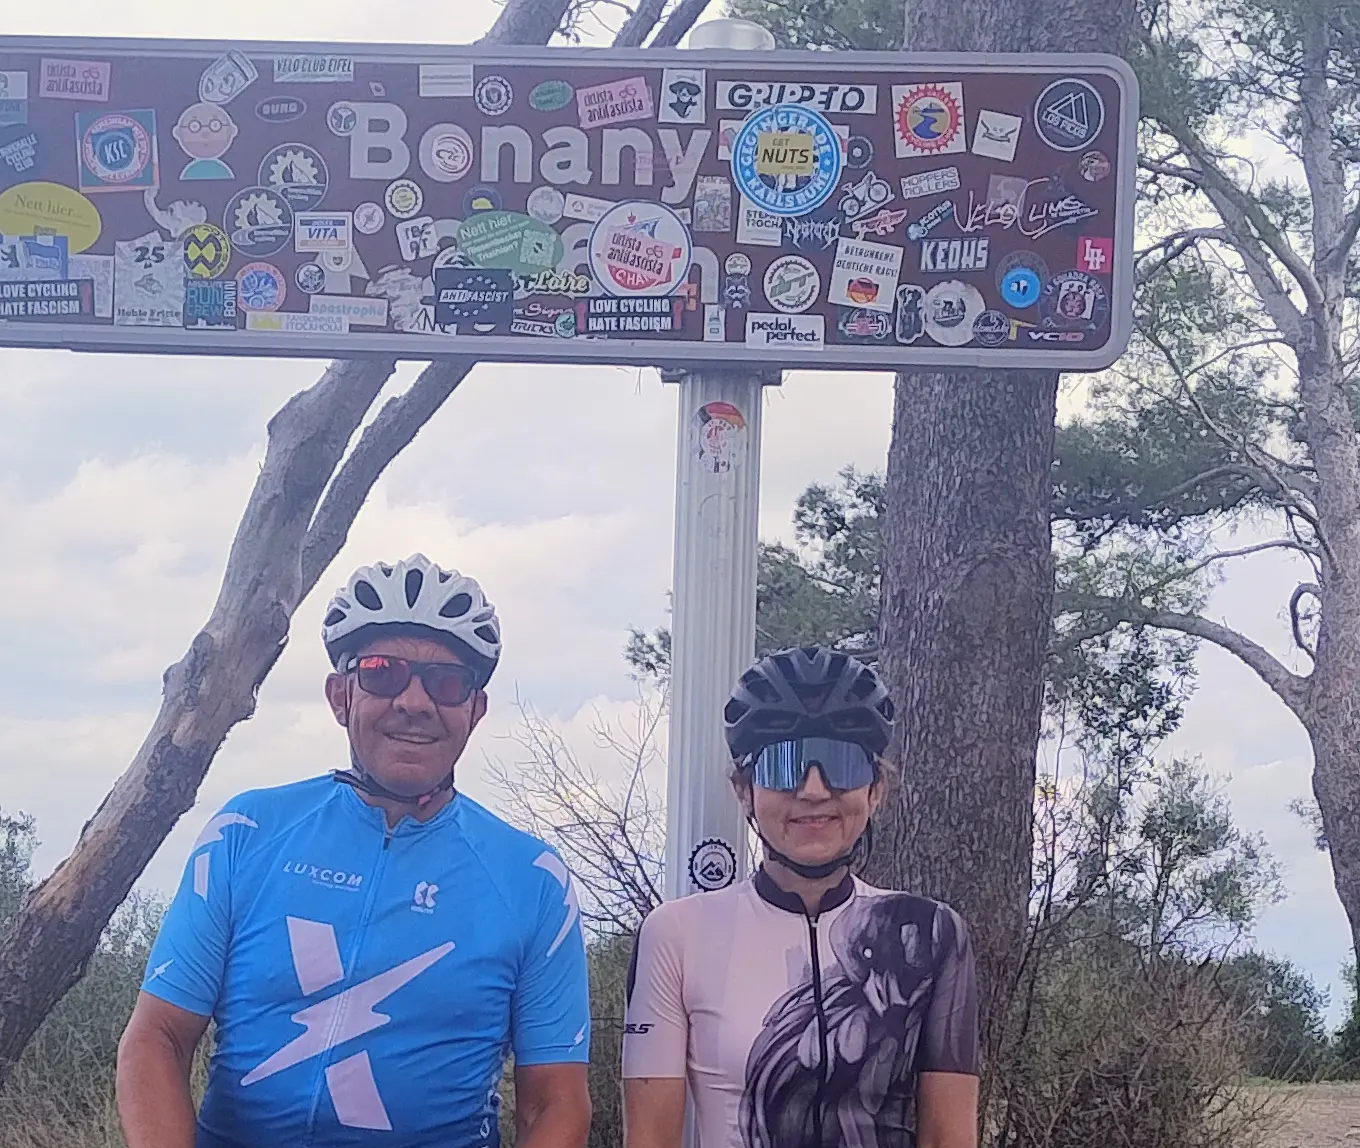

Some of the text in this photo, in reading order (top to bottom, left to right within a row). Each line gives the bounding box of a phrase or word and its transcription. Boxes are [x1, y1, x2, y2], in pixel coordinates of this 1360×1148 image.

[301, 58, 325, 72] CLUB
[104, 139, 128, 164] KSC
[350, 102, 713, 204] Bonany
[762, 149, 809, 164] NUTS
[14, 194, 44, 212] Nett
[308, 227, 338, 239] VITA
[460, 221, 488, 240] Nett
[134, 246, 165, 263] 25
[27, 283, 78, 298] CYCLING
[187, 287, 223, 303] RUN
[224, 281, 236, 317] BONN
[590, 299, 617, 313] LOVE
[619, 299, 670, 313] CYCLING
[27, 301, 80, 315] FASCISM
[187, 304, 223, 317] CREW
[589, 316, 672, 331] HATE FASCISM
[751, 317, 791, 334] pedal
[283, 860, 363, 886] LUXCOM
